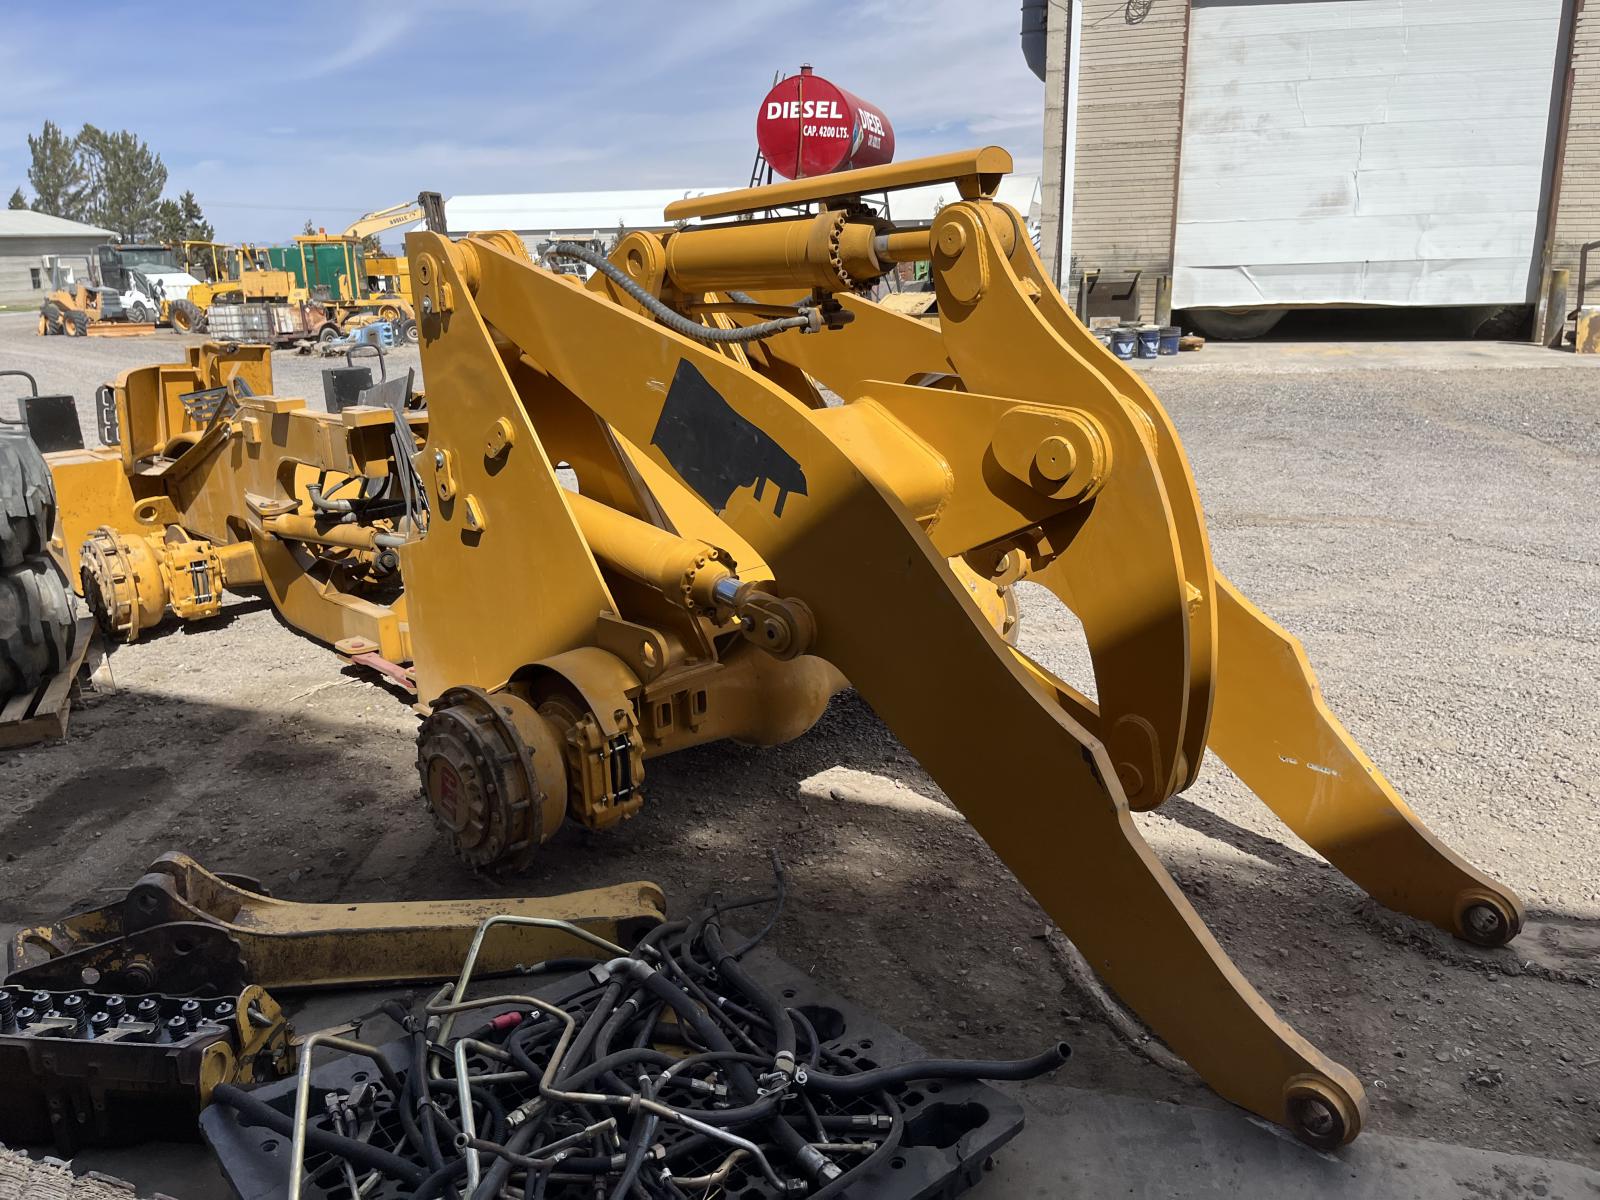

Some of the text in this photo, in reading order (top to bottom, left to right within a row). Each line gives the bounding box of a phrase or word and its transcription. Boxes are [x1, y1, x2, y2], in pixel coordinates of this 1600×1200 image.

[767, 101, 842, 119] DIESEL
[803, 125, 849, 138] CAP. 4200 LTS.
[858, 108, 886, 137] DIESEL
